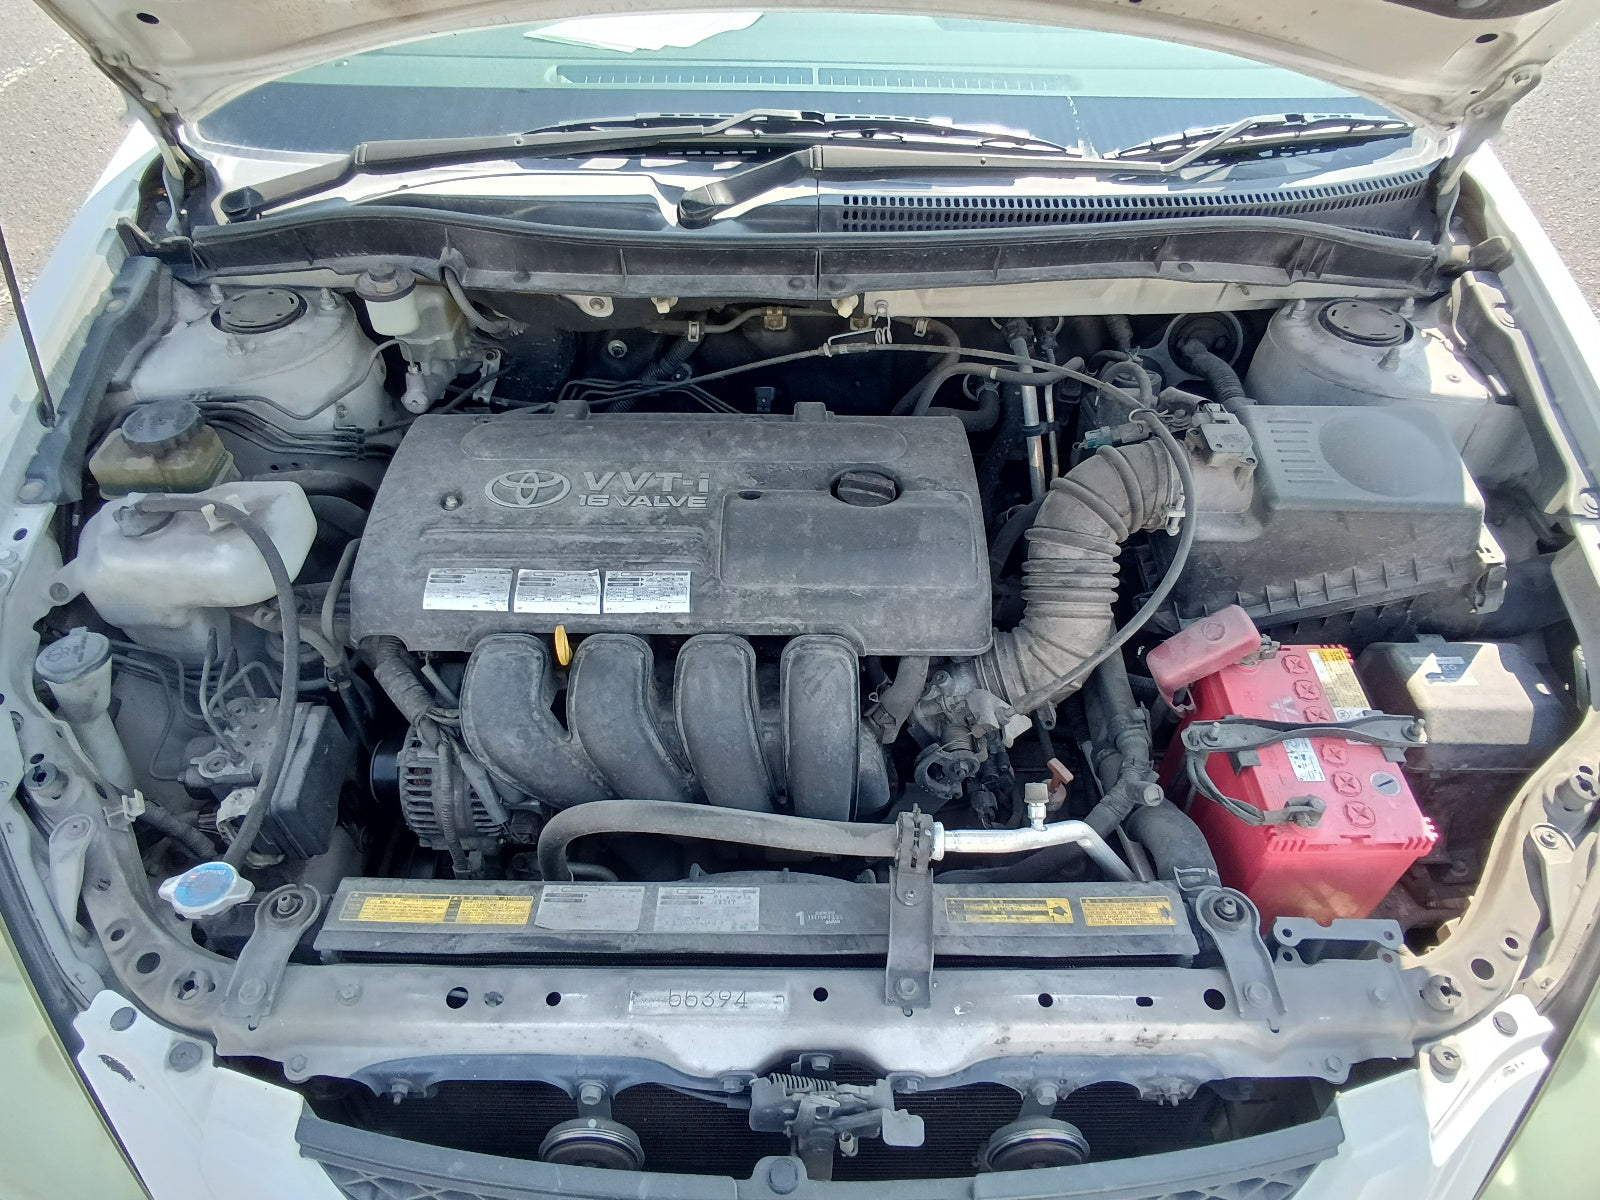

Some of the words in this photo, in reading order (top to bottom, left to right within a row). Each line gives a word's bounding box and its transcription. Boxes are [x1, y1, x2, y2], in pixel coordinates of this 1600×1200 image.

[583, 471, 710, 493] VVT-i
[578, 493, 610, 507] 16
[614, 494, 708, 509] VALVE
